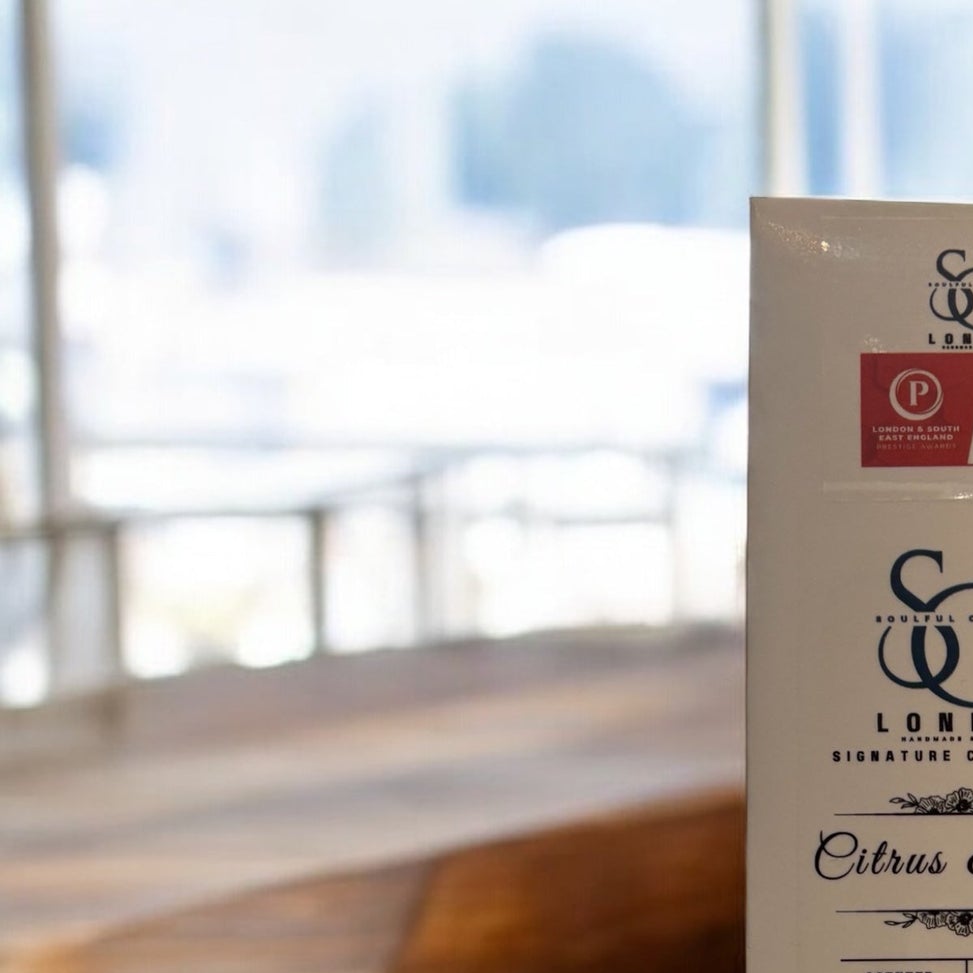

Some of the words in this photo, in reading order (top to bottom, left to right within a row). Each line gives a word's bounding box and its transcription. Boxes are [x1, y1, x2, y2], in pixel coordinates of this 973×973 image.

[908, 381, 929, 406] P
[876, 615, 955, 623] SOULFUL
[832, 750, 951, 762] SIGNATURE
[814, 830, 947, 880] Citrus
